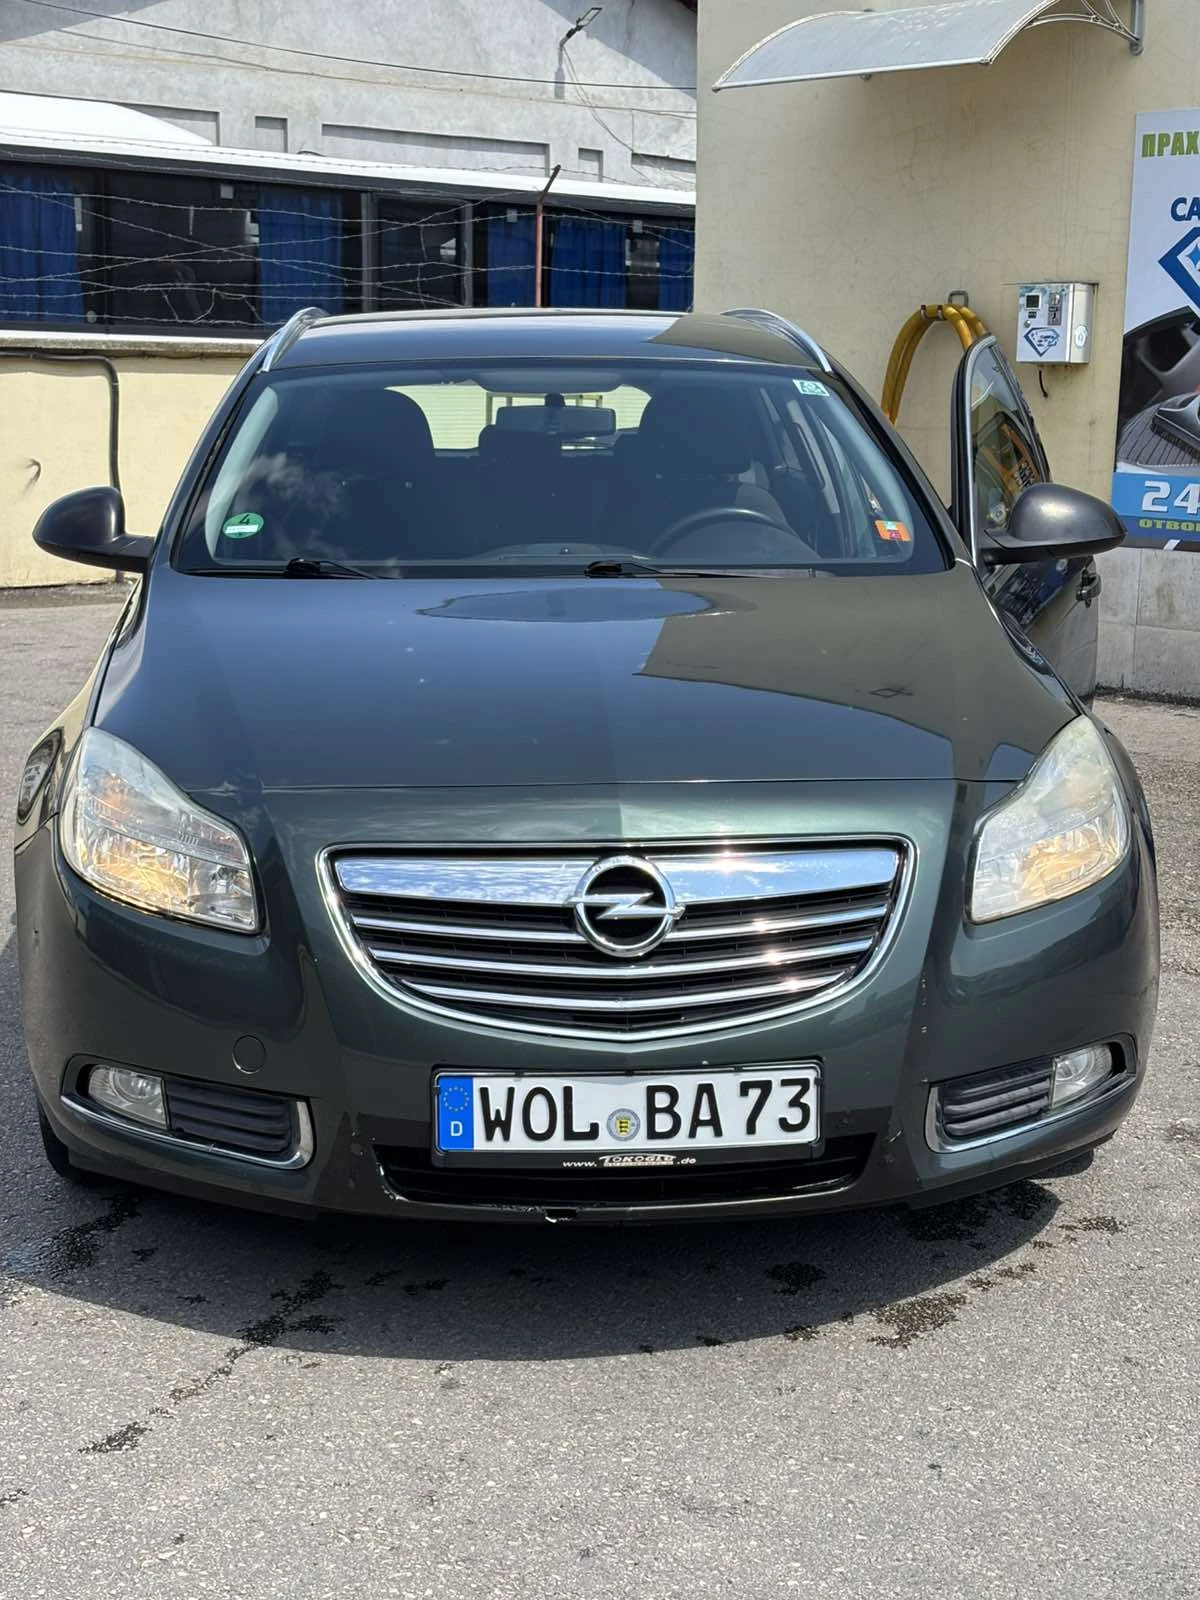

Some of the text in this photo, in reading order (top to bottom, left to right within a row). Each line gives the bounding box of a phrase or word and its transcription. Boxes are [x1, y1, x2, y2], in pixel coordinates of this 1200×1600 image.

[1141, 131, 1200, 158] ПРАХ
[1142, 480, 1200, 514] 24
[239, 513, 249, 525] 4
[479, 1077, 811, 1142] WOL BA 73
[450, 1121, 463, 1137] D
